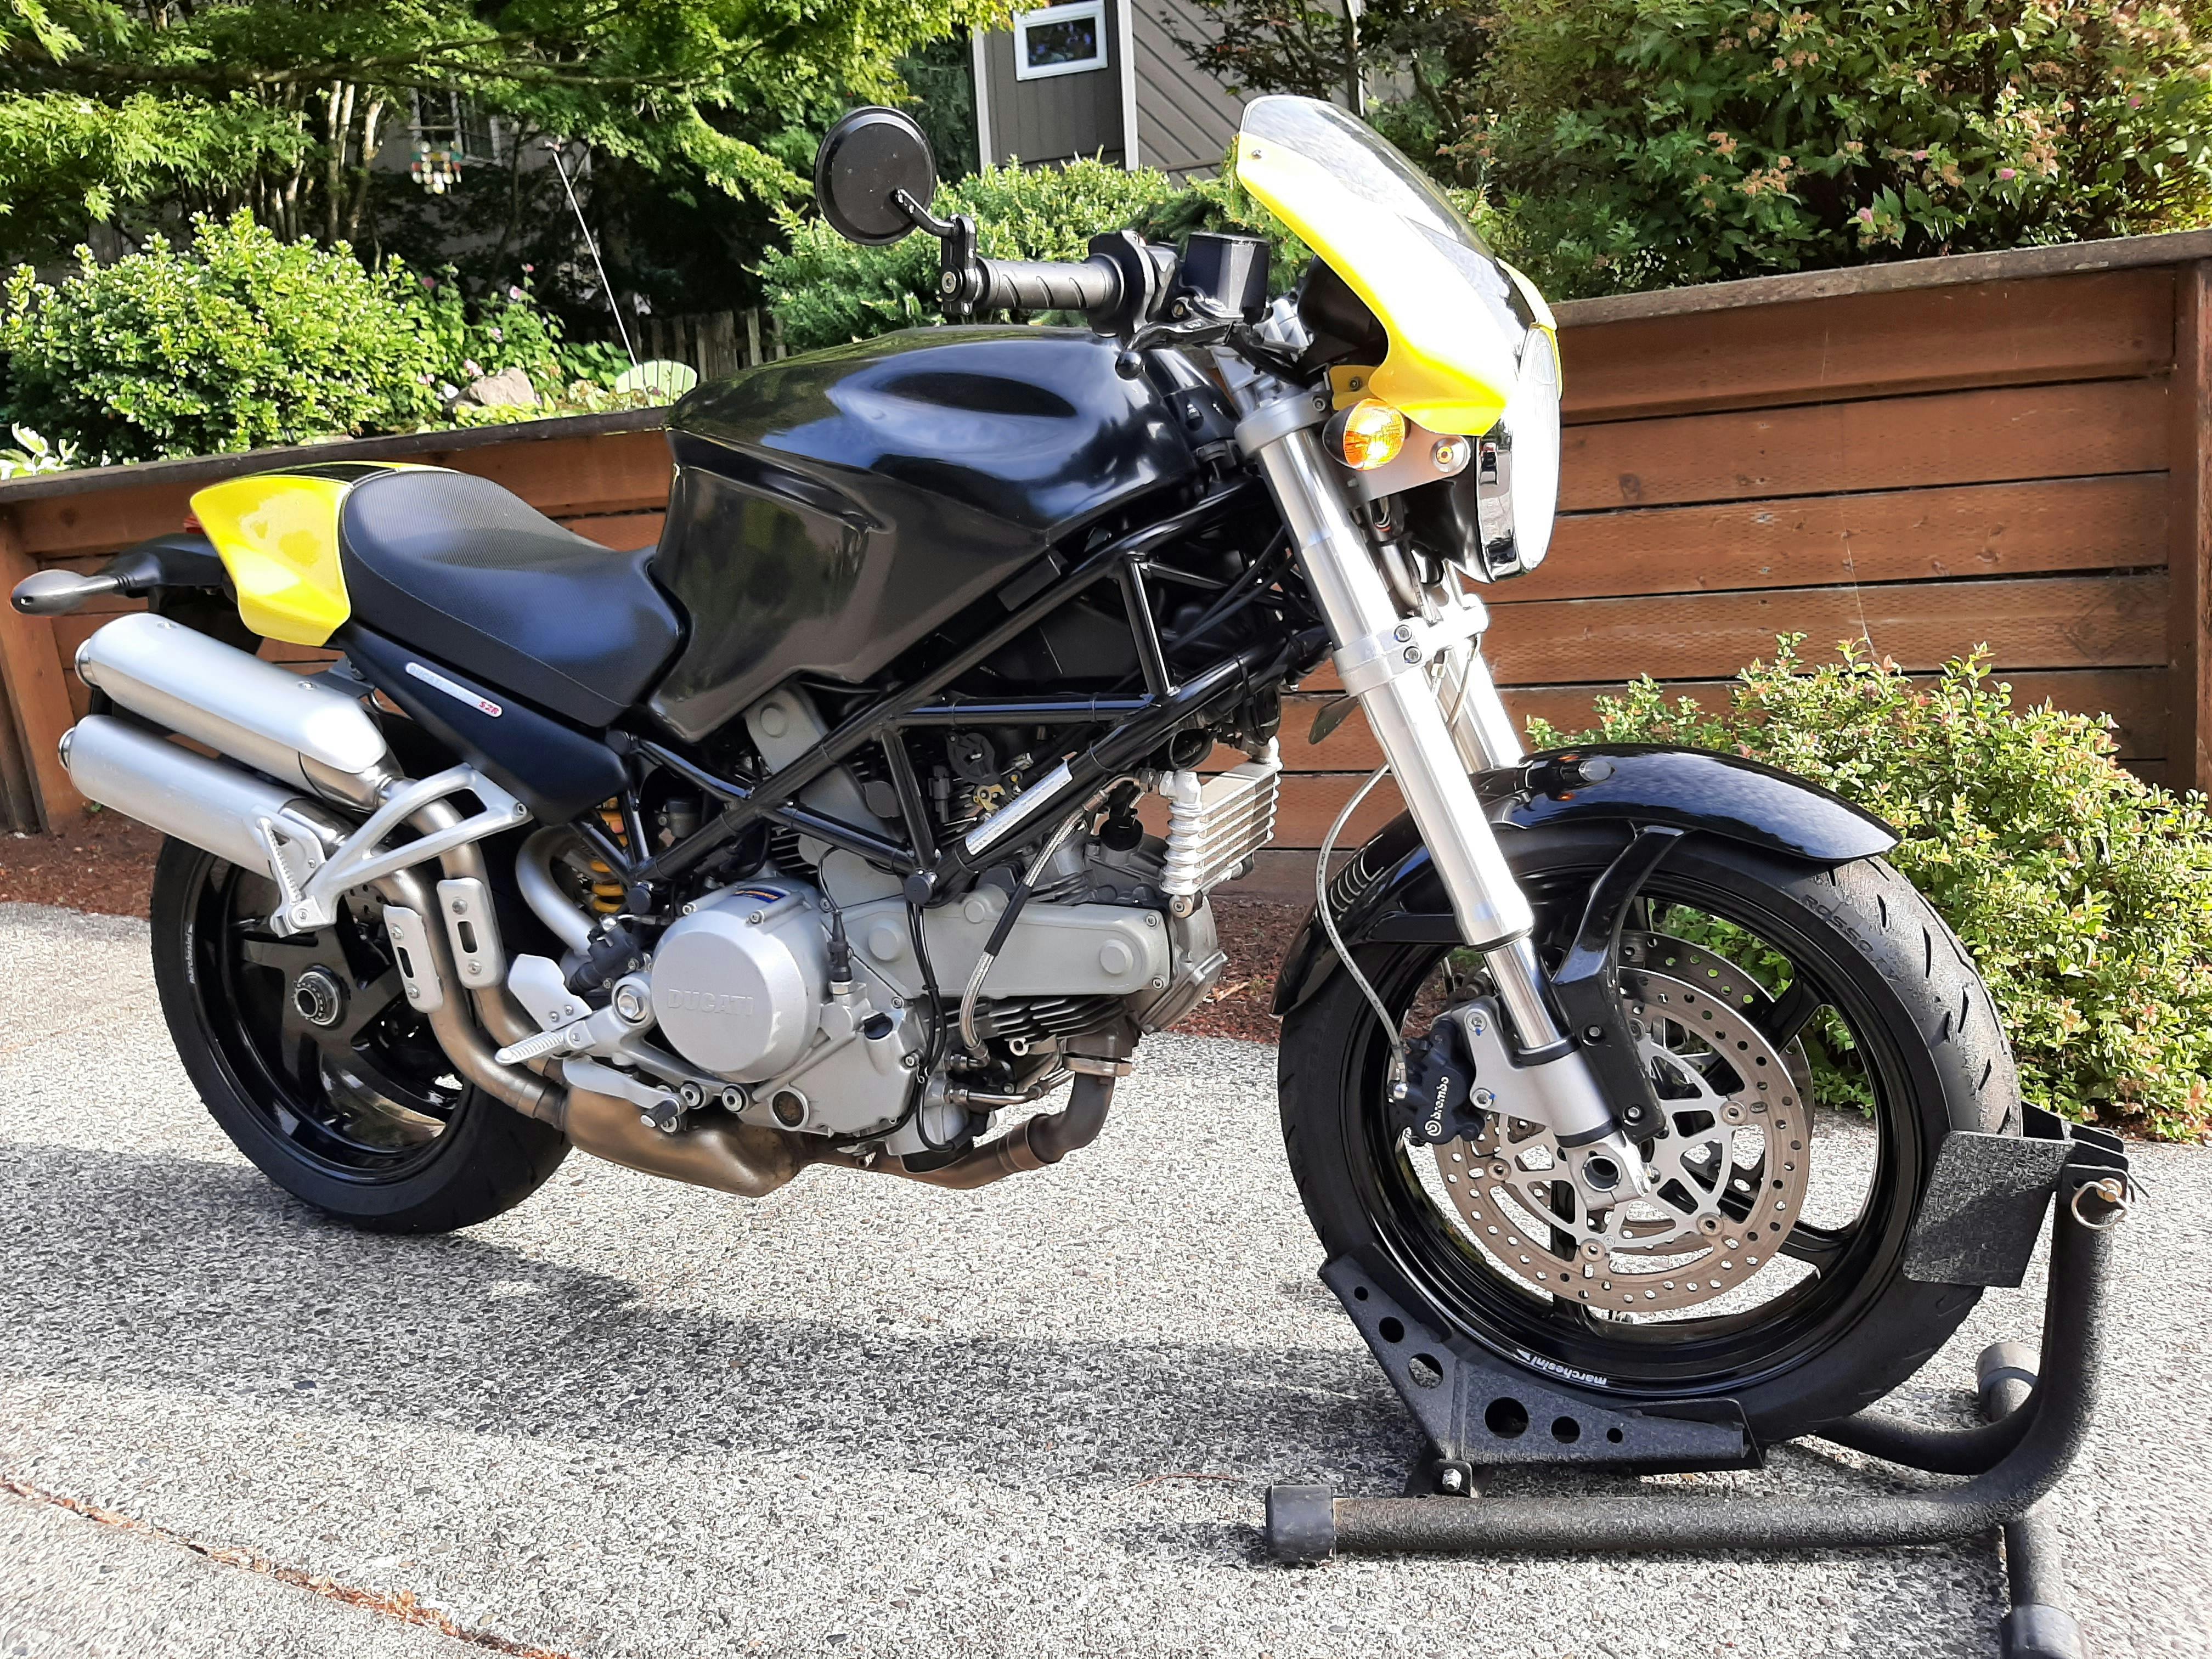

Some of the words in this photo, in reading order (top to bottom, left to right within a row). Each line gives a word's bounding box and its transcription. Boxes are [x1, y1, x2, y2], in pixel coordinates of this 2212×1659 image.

[479, 701, 500, 714] S2R
[1803, 894, 1874, 953] ROSSO
[668, 989, 754, 1016] DUCATI
[1430, 1076, 1449, 1120] brembo
[1530, 1356, 1607, 1385] marchesini
